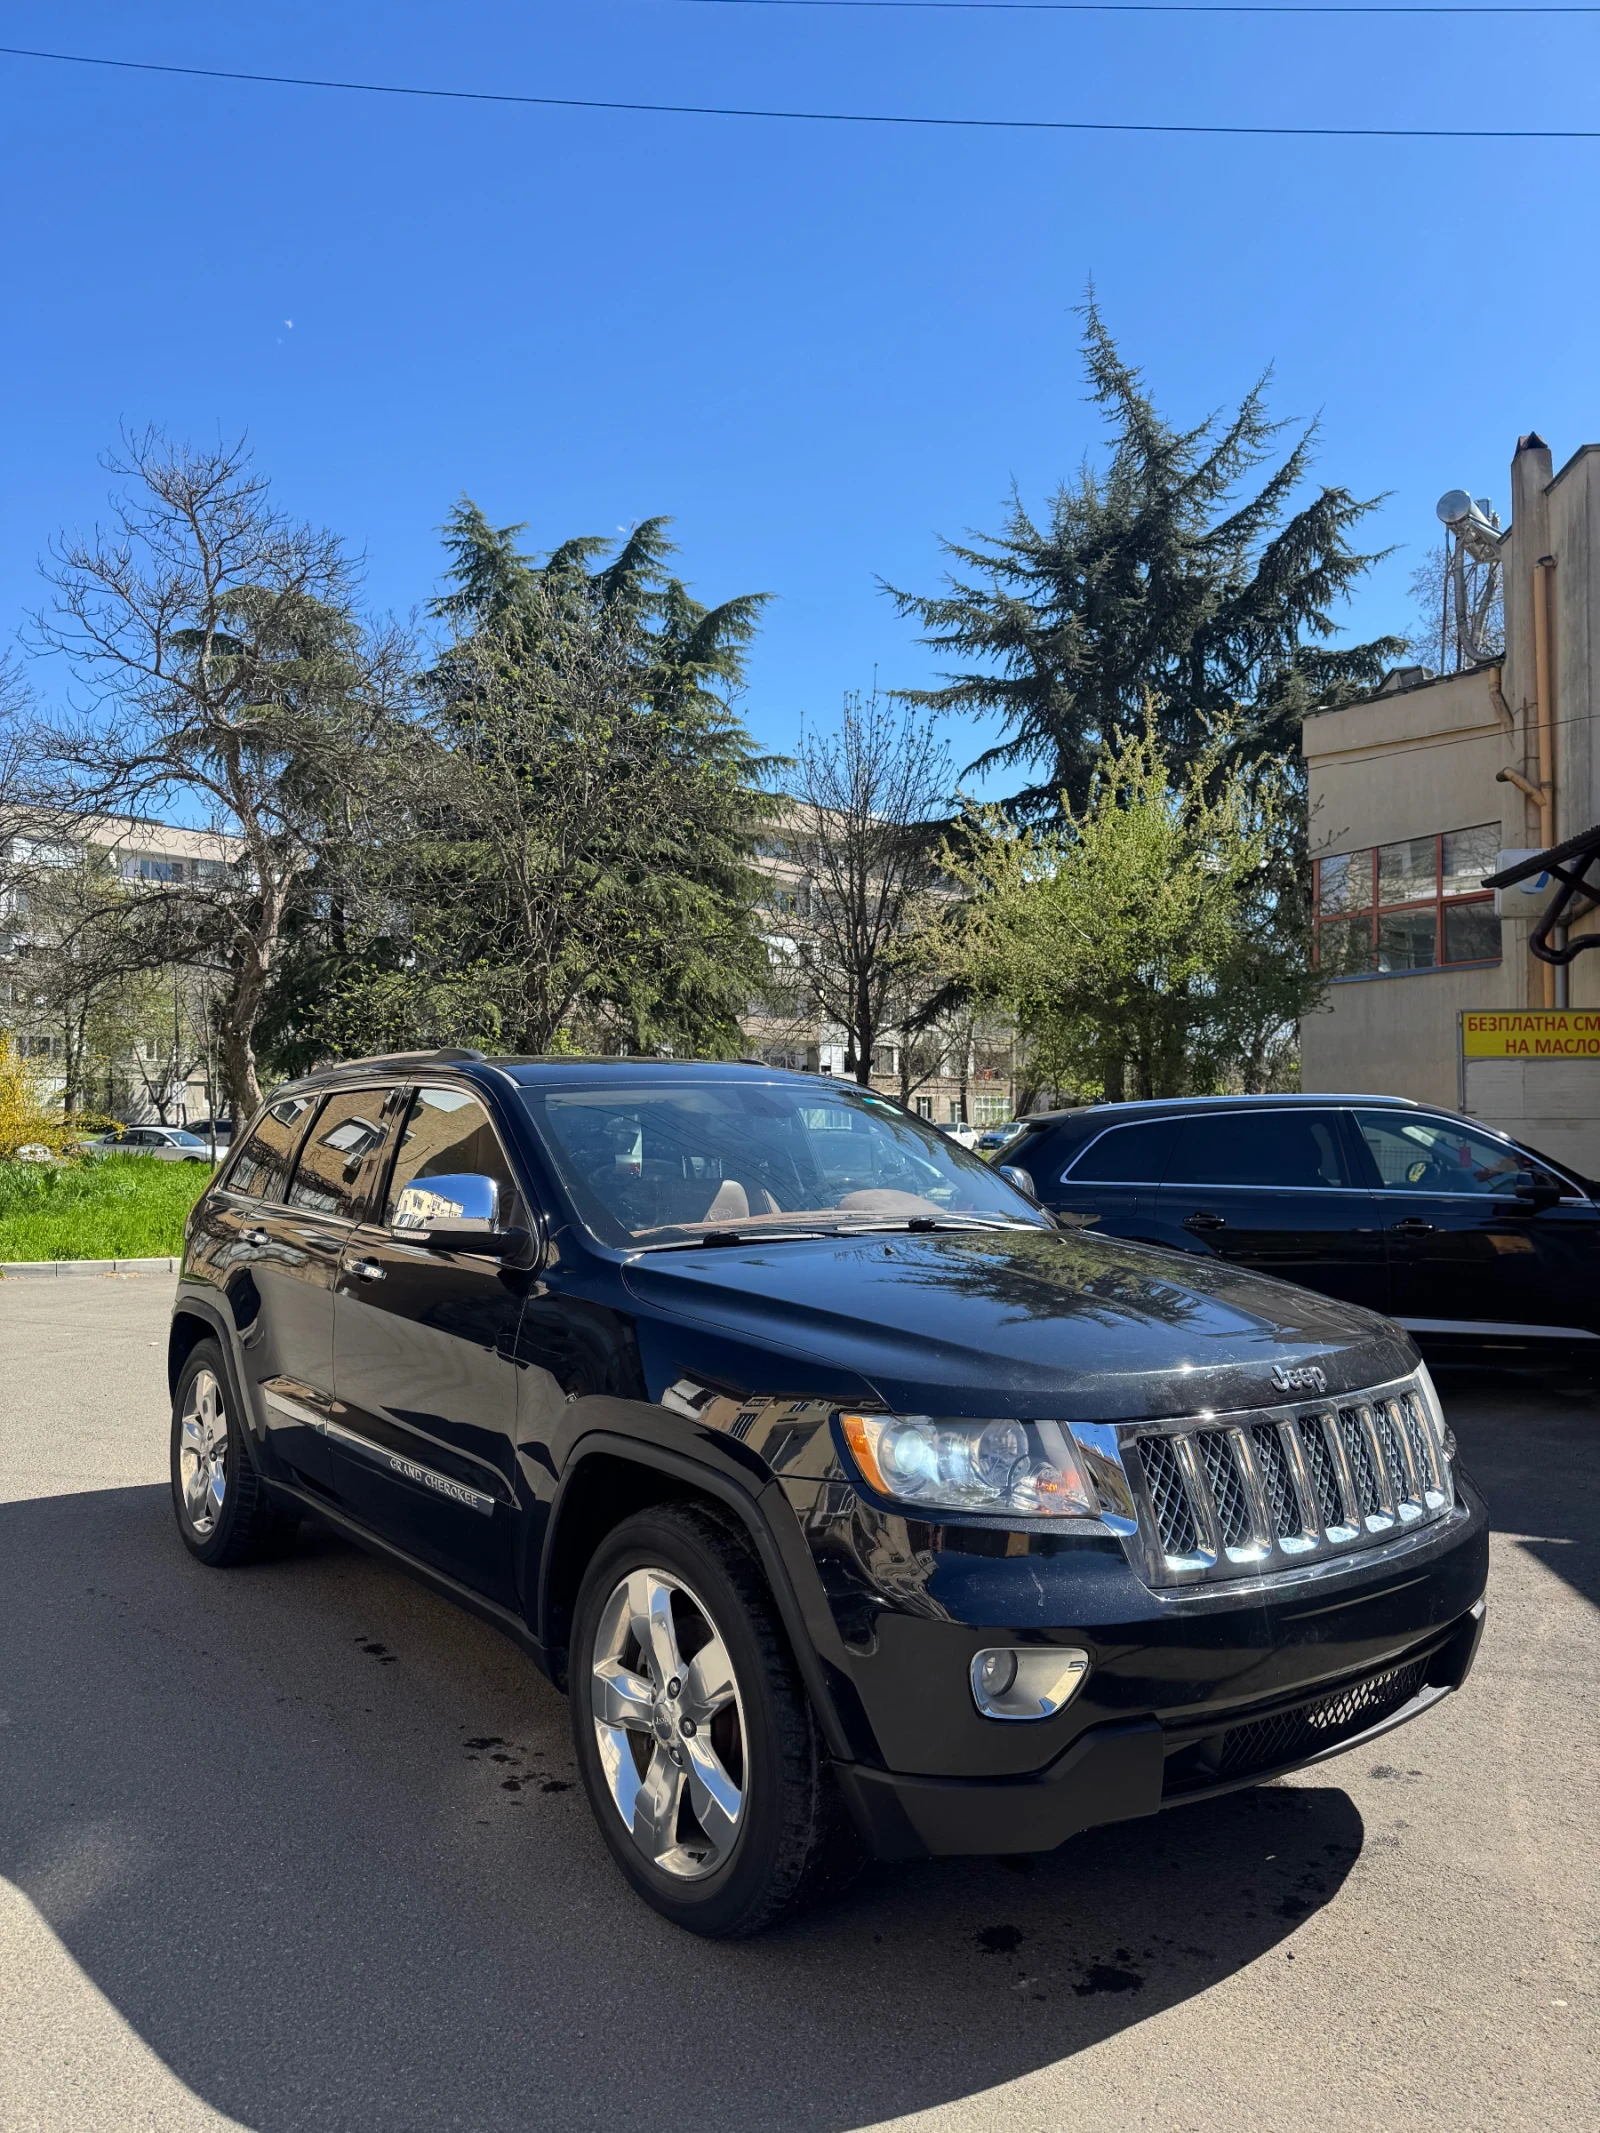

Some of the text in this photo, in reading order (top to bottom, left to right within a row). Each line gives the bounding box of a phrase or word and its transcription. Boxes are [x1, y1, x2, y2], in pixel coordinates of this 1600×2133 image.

[1468, 1016, 1600, 1031] БЕЗПЛАТНА СМ
[1505, 1038, 1600, 1054] НА МАСЛО
[1271, 1365, 1328, 1392] Jeep
[389, 1458, 479, 1508] GRAND CHEROKEE
